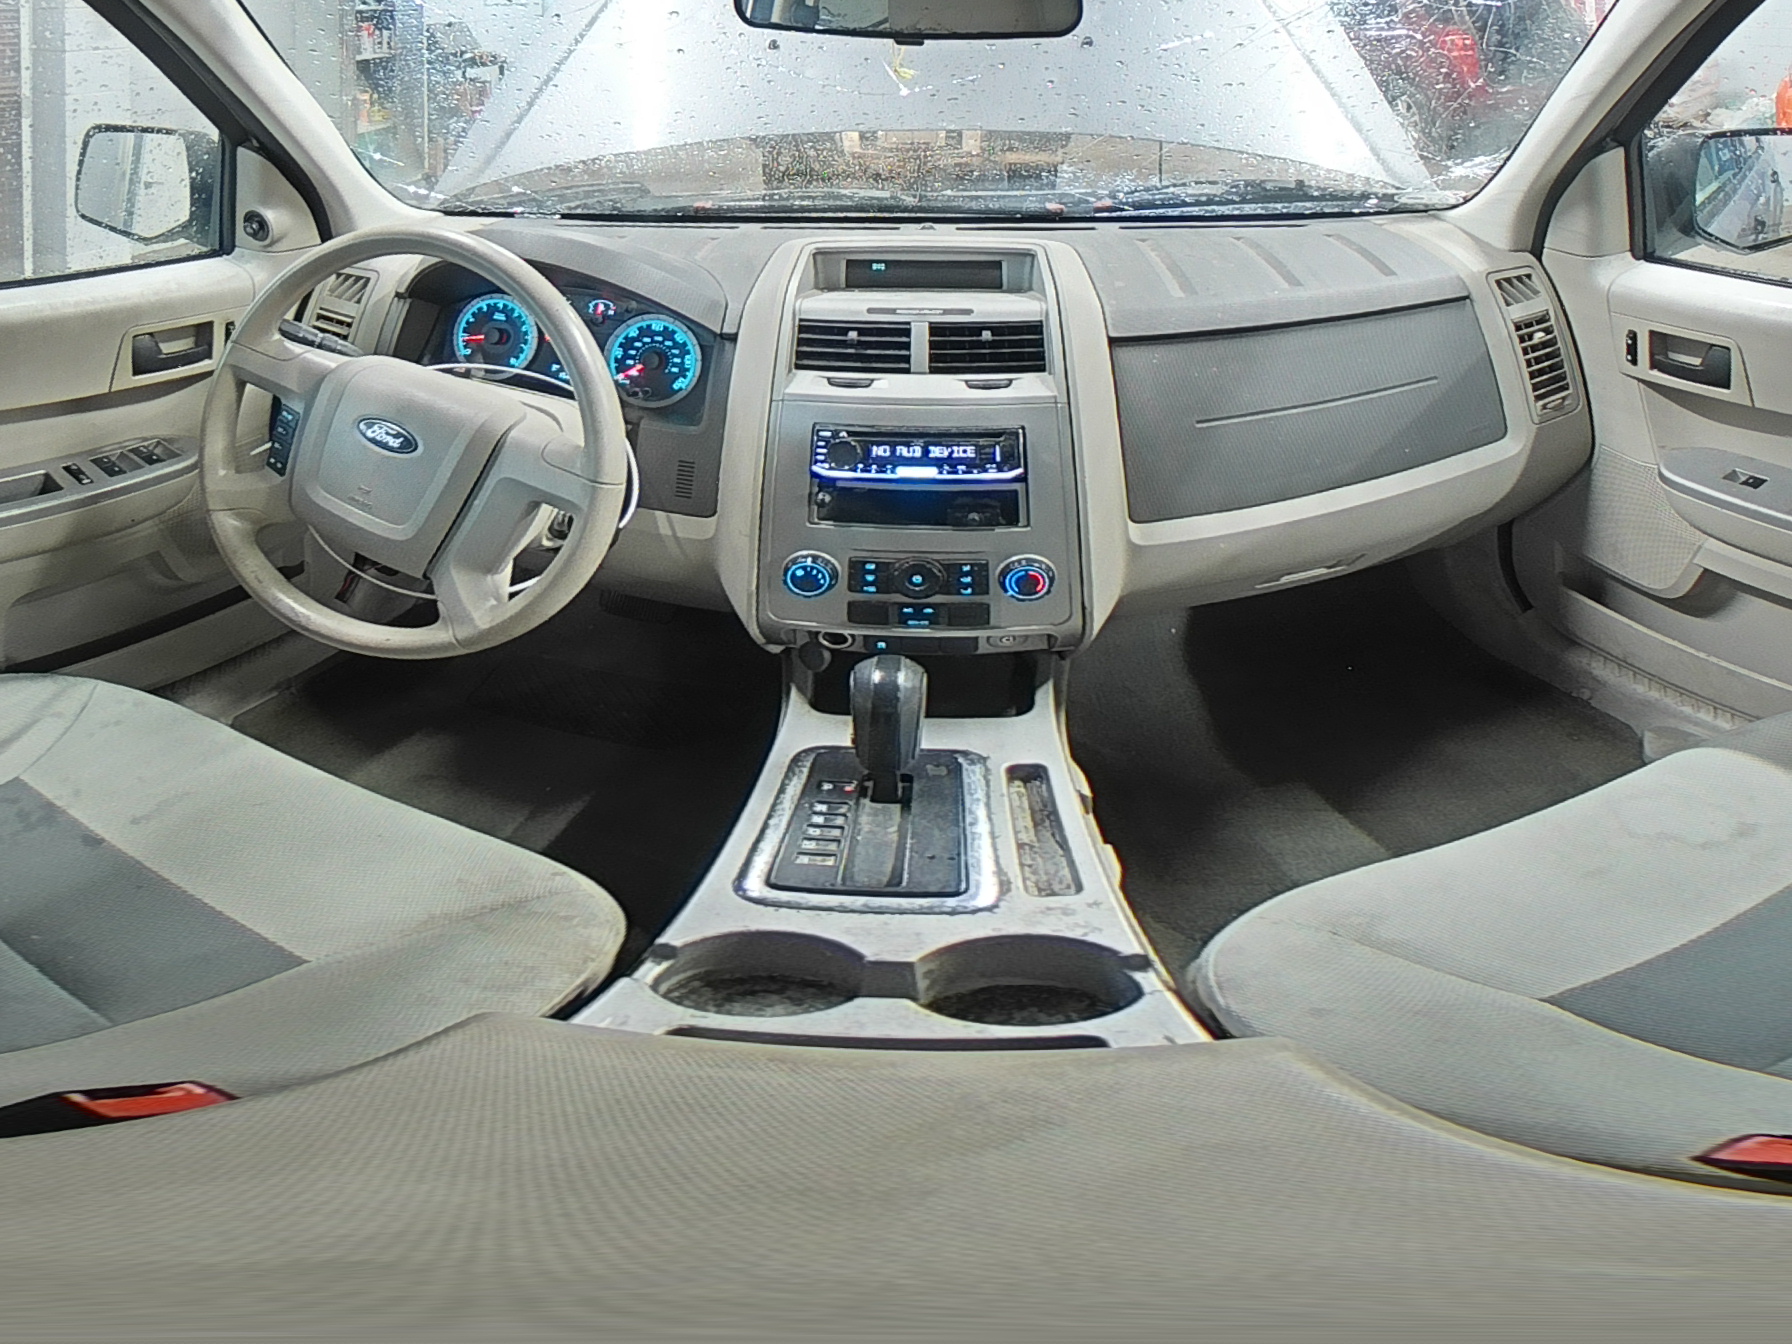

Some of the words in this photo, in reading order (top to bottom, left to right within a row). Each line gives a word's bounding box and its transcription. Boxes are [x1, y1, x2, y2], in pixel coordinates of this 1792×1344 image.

[366, 423, 401, 448] Ford
[871, 445, 891, 458] NO
[928, 445, 976, 458] DEVICE
